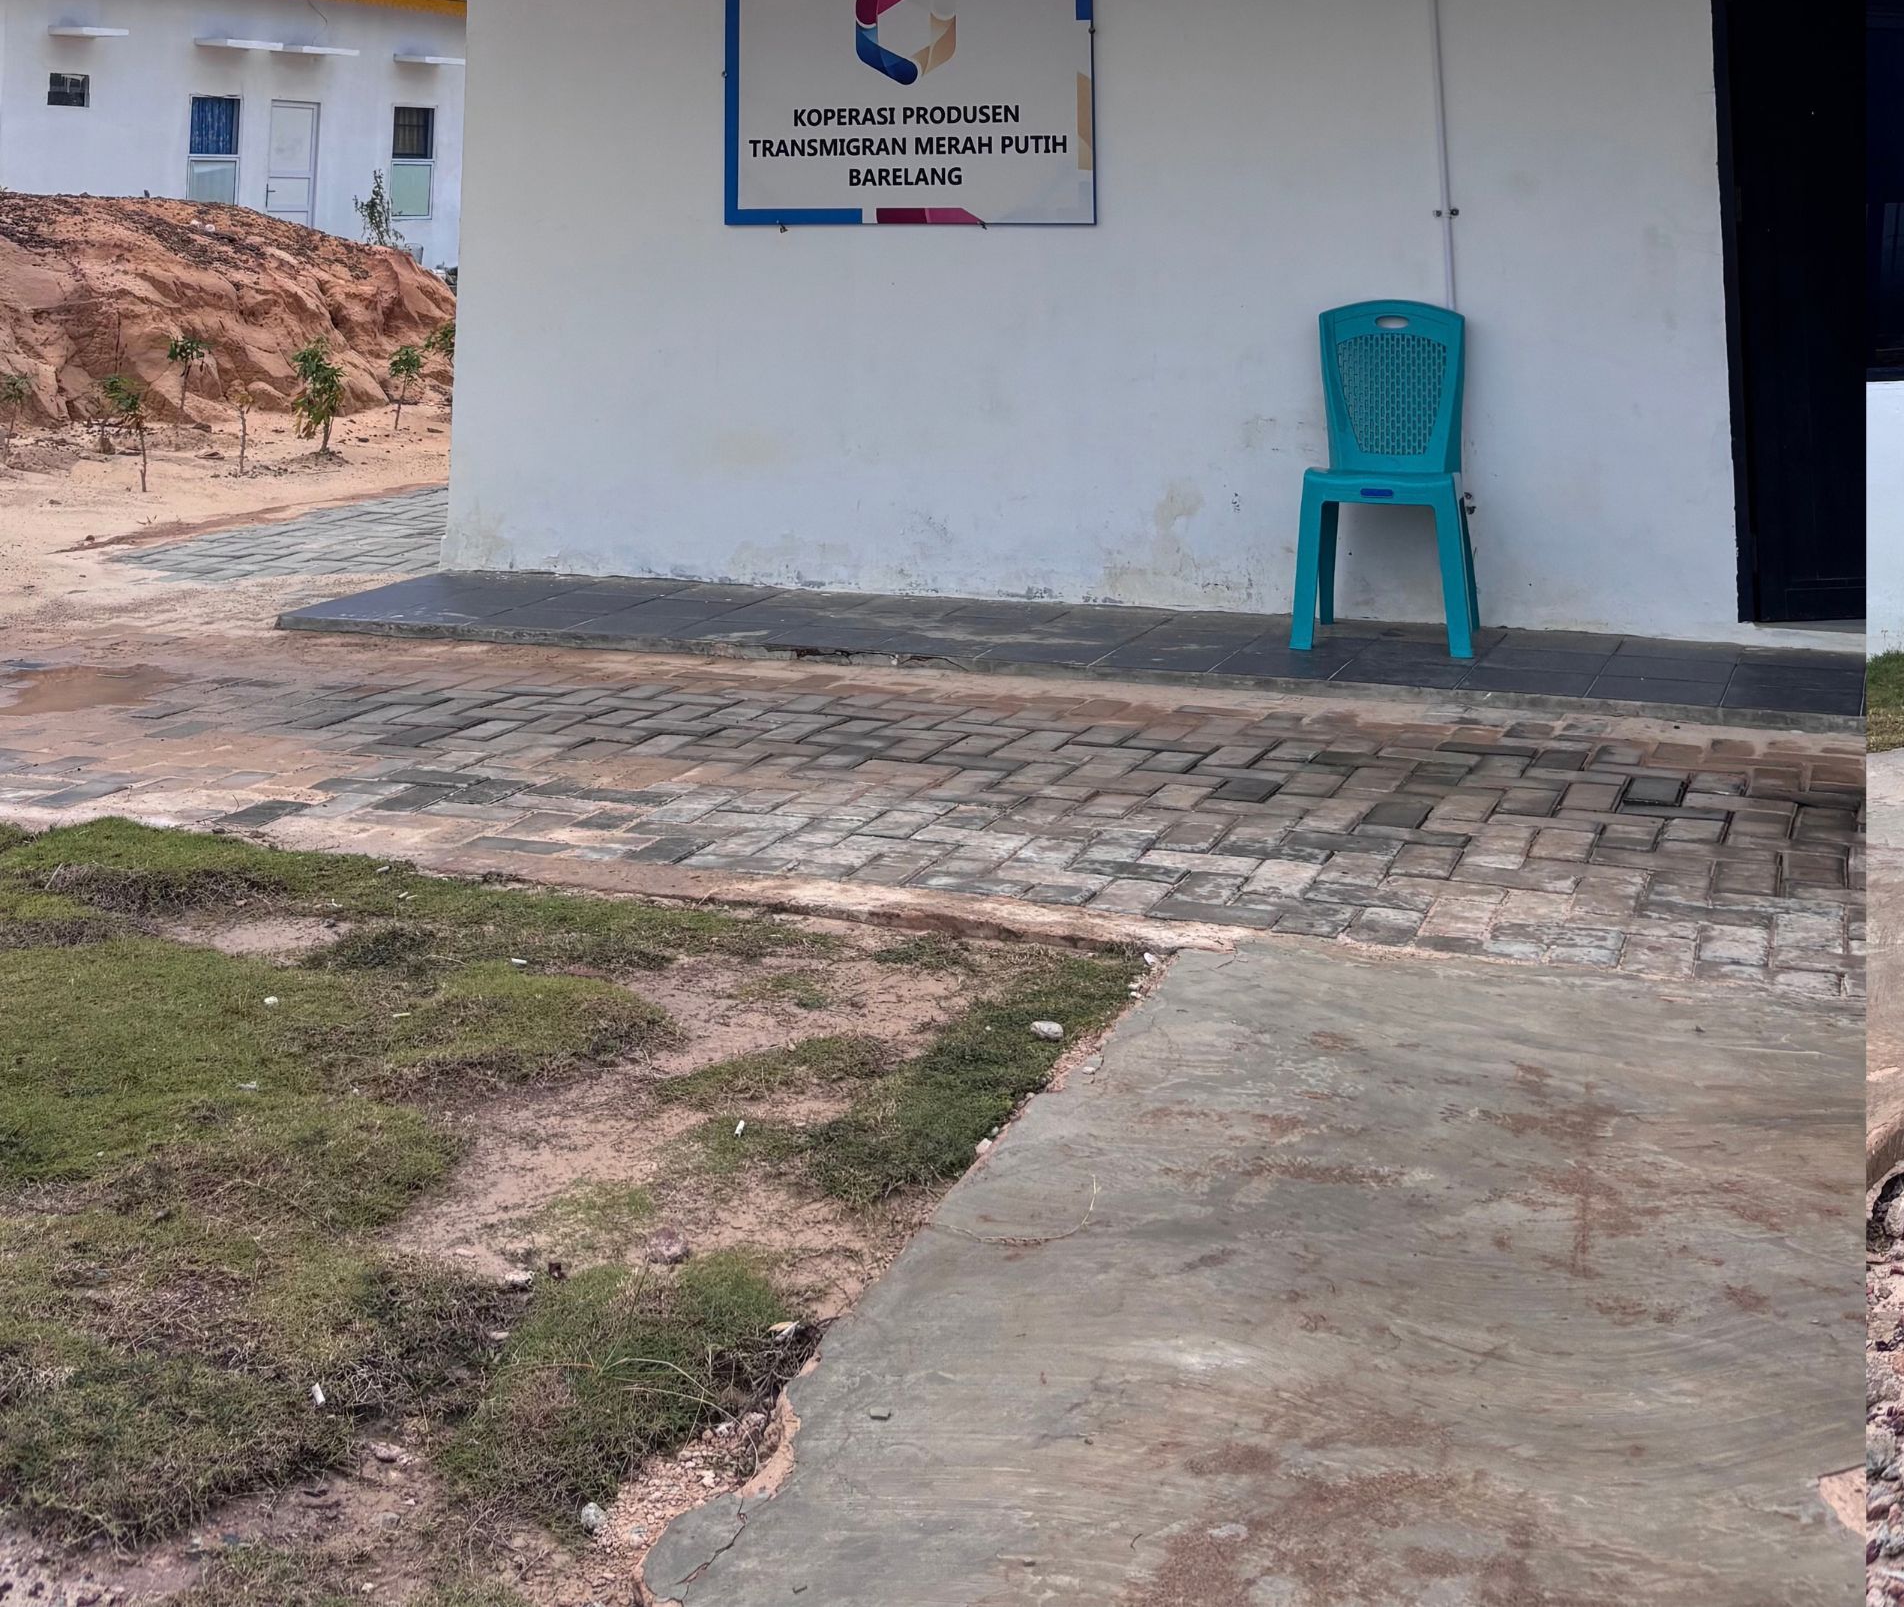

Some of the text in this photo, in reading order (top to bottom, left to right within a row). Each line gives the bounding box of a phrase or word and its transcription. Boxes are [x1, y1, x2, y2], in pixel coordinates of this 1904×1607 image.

[793, 105, 1020, 127] KOPERASI PRODUSEN
[749, 135, 1067, 157] TRANSMIGRAN MERAH PUTIH
[849, 167, 963, 186] BARELANG
